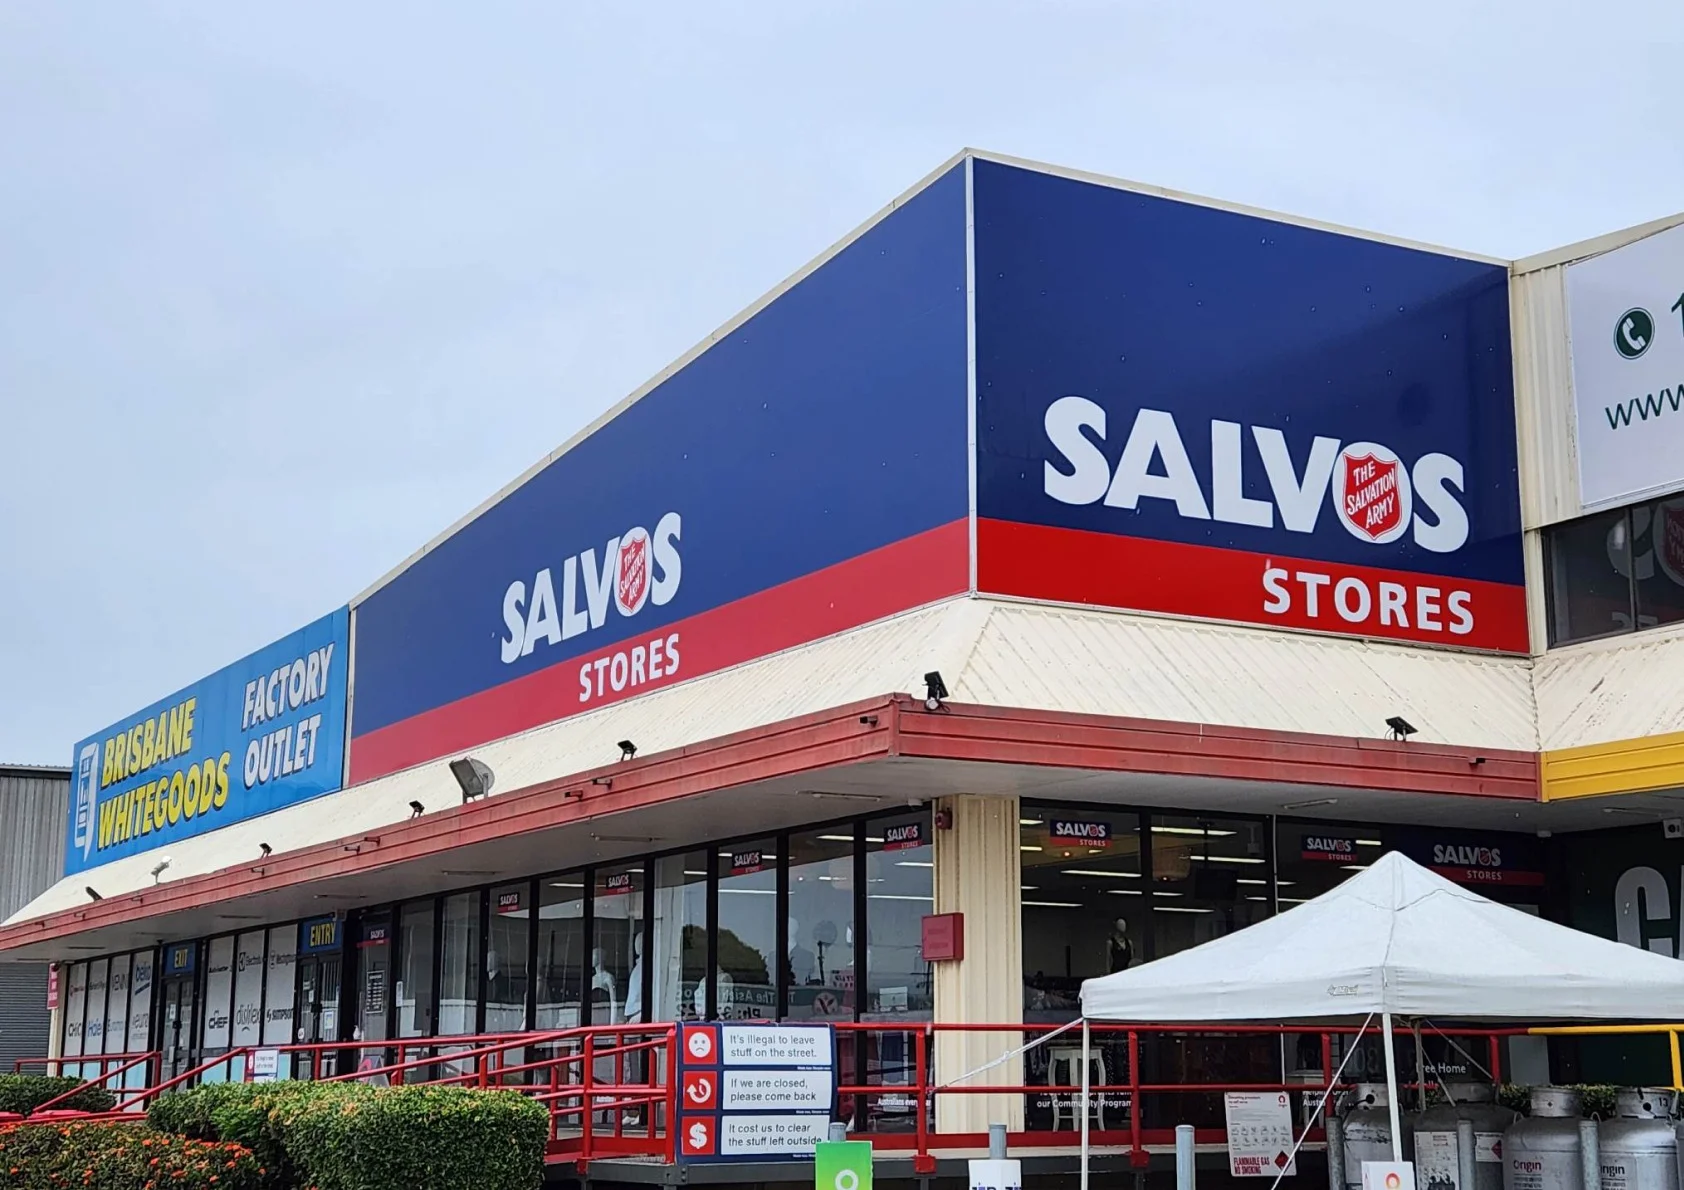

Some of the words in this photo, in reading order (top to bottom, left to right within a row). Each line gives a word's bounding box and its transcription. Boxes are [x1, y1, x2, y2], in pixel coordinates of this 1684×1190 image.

[1044, 396, 1469, 553] SALVOS
[1353, 461, 1376, 486] THE
[1347, 468, 1395, 516] SALVATION
[1366, 492, 1395, 529] ARMY
[624, 543, 636, 572] THE
[501, 512, 682, 664] SALVOS
[628, 564, 644, 605] ARMY
[1263, 567, 1474, 635] STORES
[579, 633, 680, 702] STORES
[242, 642, 336, 732] FACTORY
[101, 696, 196, 790] BRISBANE
[243, 713, 322, 790] OUTLET
[97, 751, 231, 852] WHITEGOODS
[888, 826, 919, 841] SALVOS
[1056, 822, 1106, 838] SALVOS
[1079, 839, 1106, 847] STORES
[1306, 837, 1352, 852] SALVOS
[734, 852, 760, 867] SALVOS
[1328, 853, 1352, 861] STORES
[1434, 844, 1502, 867] SALVOS
[1467, 870, 1502, 881] STORES
[310, 922, 337, 947] ENTRY
[174, 949, 188, 969] EXIT
[730, 1035, 744, 1045] It's
[779, 1035, 788, 1045] to
[791, 1035, 815, 1045] leave
[731, 1048, 752, 1057] stuff
[770, 1048, 785, 1057] the
[788, 1048, 817, 1058] street.
[731, 1079, 738, 1088] If
[740, 1080, 753, 1088] we
[756, 1080, 771, 1088] are
[774, 1079, 808, 1089] closed,
[730, 1092, 762, 1103] please
[794, 1092, 816, 1101] back
[1036, 1100, 1051, 1108] our
[729, 1124, 736, 1133] It
[738, 1124, 758, 1133] cost
[761, 1125, 773, 1133] us
[776, 1124, 785, 1133] to
[788, 1124, 811, 1133] clear
[728, 1137, 743, 1147] the
[746, 1137, 767, 1146] stuff
[769, 1137, 785, 1146] left
[1234, 1157, 1260, 1166] FLAMMABLE
[1261, 1156, 1270, 1166] GAS
[1513, 1160, 1542, 1173] Origin
[1242, 1166, 1261, 1175] SMOKING
